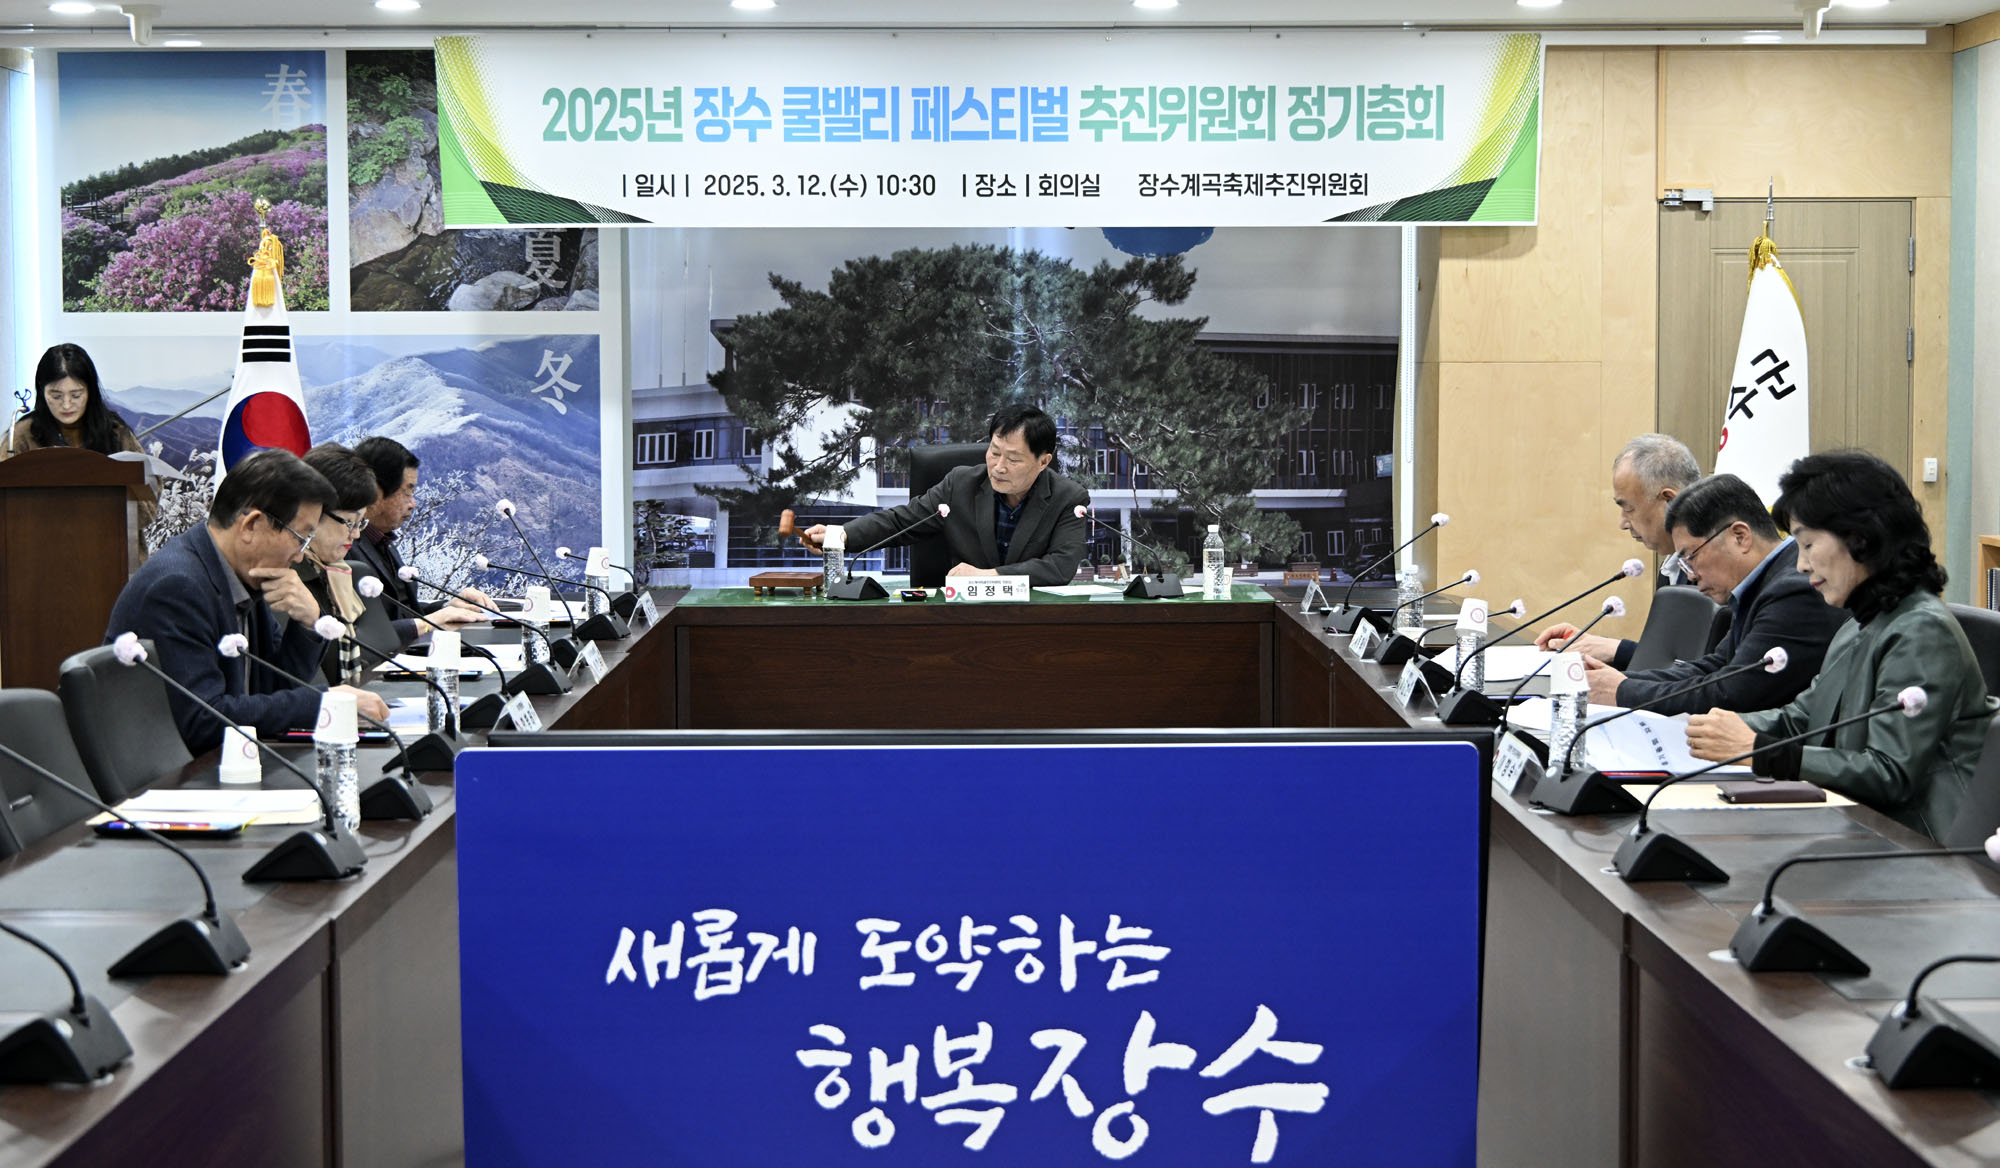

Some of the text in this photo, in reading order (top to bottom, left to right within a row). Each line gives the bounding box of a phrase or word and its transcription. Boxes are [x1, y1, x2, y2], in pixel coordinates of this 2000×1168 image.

[261, 63, 312, 124] 春
[542, 84, 1445, 143] 2025년 장수 쿨밸리 페스티벌 추진위원회 정기총회
[704, 174, 766, 198] 2025.
[772, 174, 792, 198] 3.
[876, 174, 936, 197] 10:30
[1038, 173, 1100, 198] 회의실
[1138, 172, 1368, 198] 장수계곡축제추진위원회
[519, 228, 568, 289] 夏
[531, 349, 582, 416] 冬
[606, 908, 1171, 1001] 새롭게 도약하는
